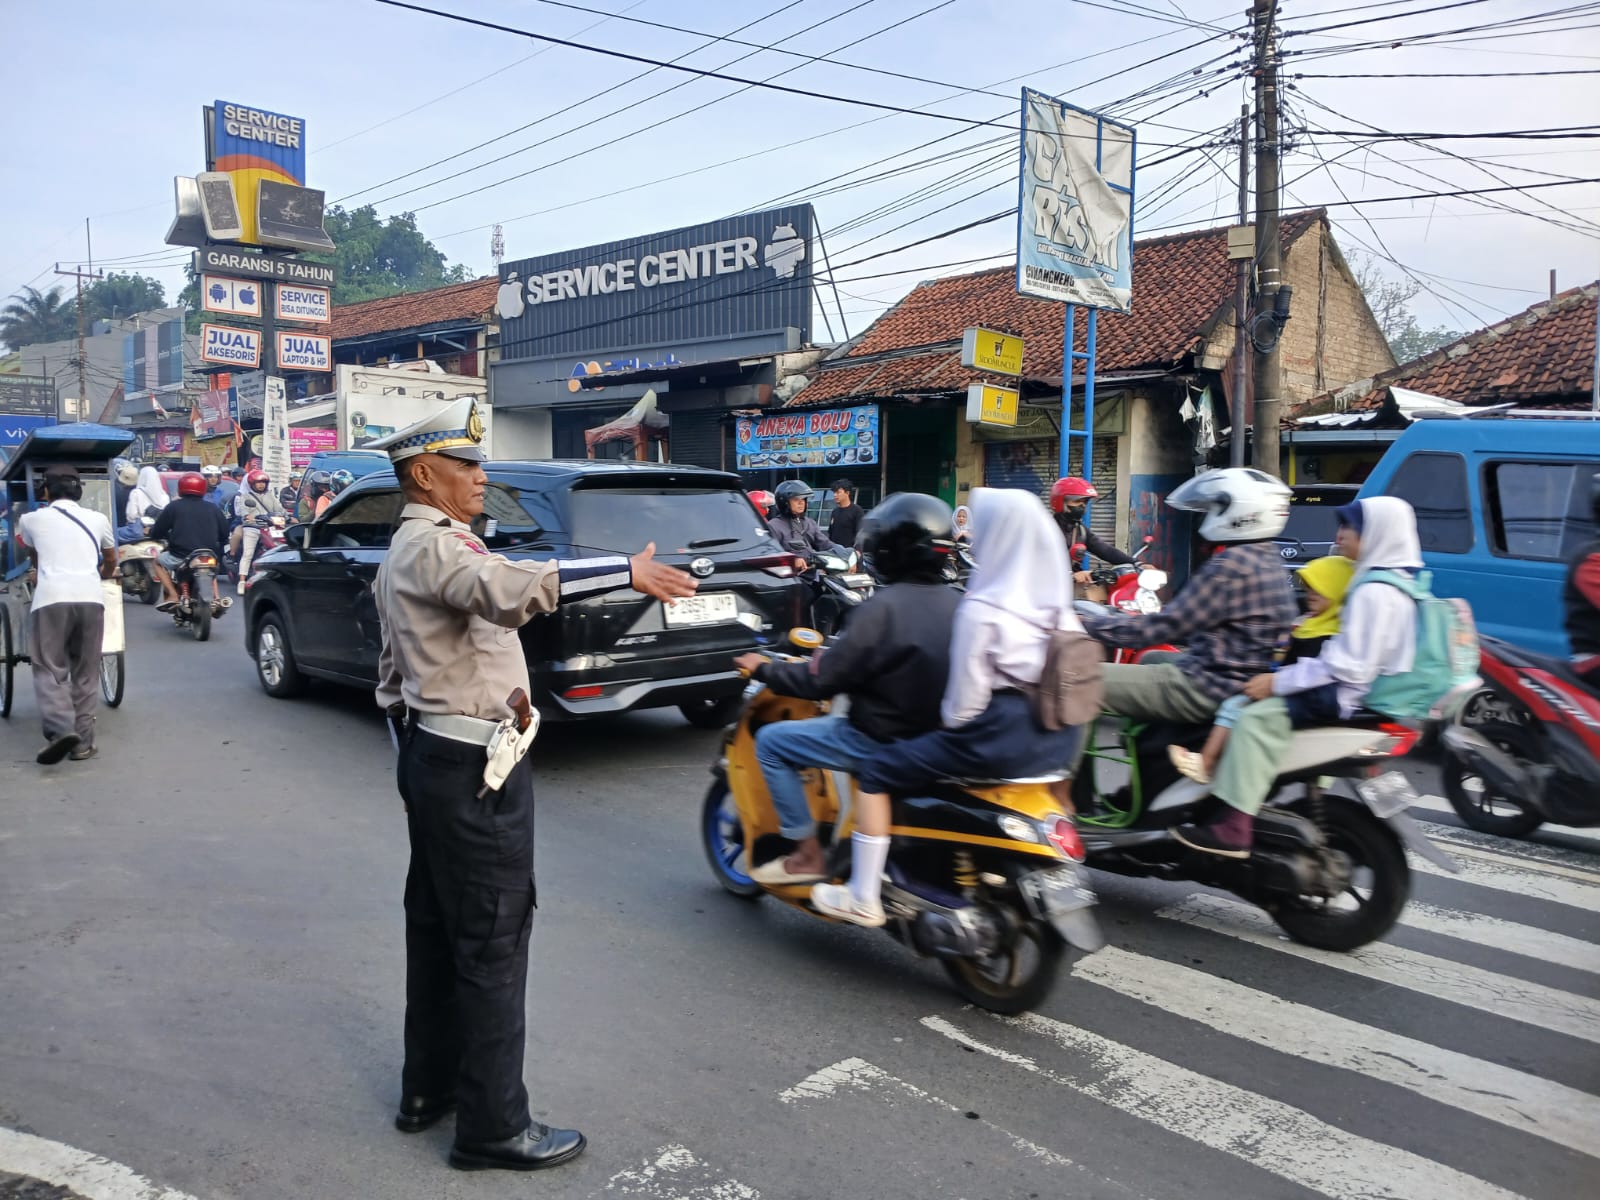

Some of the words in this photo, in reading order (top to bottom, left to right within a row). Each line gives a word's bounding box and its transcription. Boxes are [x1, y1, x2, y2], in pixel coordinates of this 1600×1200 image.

[224, 104, 302, 134] SERVICE
[226, 121, 300, 149] CENTER
[207, 251, 275, 274] GARANSI
[276, 262, 285, 275] 5
[286, 263, 334, 282] TAHUN
[526, 256, 636, 306] SERVICE
[637, 236, 760, 289] CENTER
[280, 289, 326, 306] SERVICE
[281, 304, 295, 314] BISA
[296, 305, 327, 317] DITUNGGU
[207, 330, 256, 351] JUAL
[284, 337, 324, 355] JUAL
[207, 346, 256, 362] AKSESORIS
[282, 353, 310, 365] LAPTOP
[310, 357, 316, 365] &
[316, 358, 327, 366] HP
[755, 414, 807, 438] ANEKA
[809, 411, 852, 433] BOLU
